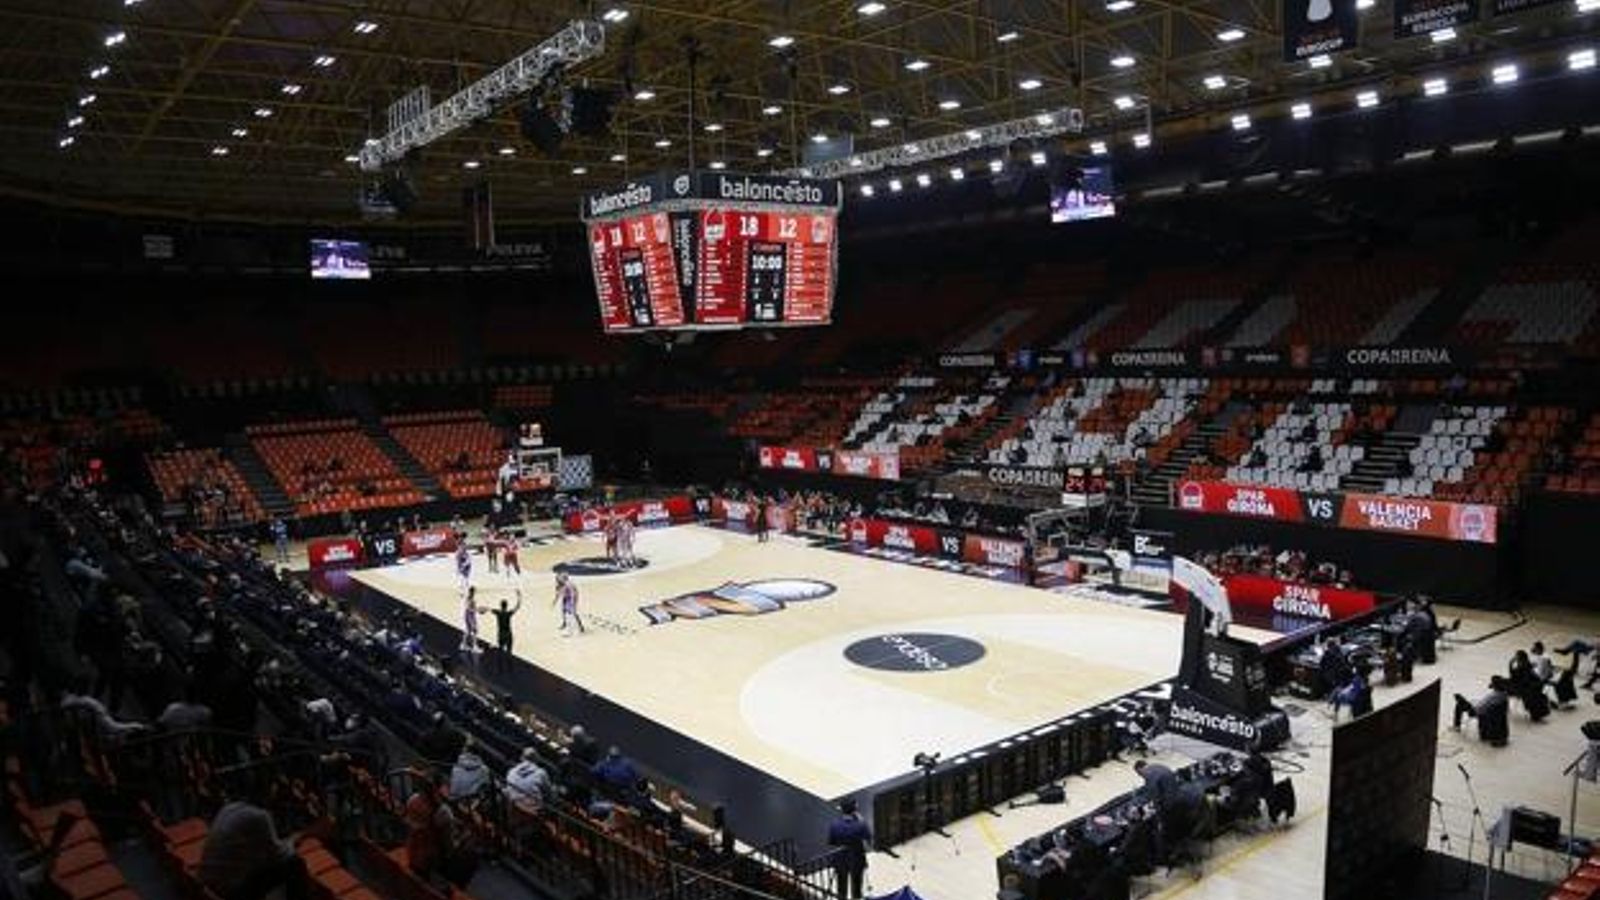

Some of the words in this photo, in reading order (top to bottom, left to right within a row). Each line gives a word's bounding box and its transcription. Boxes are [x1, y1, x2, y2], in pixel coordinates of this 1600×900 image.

[720, 175, 823, 202] baloncesto
[591, 183, 652, 215] baloncesto
[739, 215, 759, 236] 18
[778, 217, 799, 239] 12
[752, 254, 783, 270] 10:00
[1308, 498, 1334, 519] VS
[1357, 500, 1432, 520] VALENCIA
[1369, 514, 1421, 530] BASKET
[375, 539, 396, 555] VS
[942, 536, 959, 553] VS
[1285, 585, 1321, 602] SPAR
[1272, 594, 1332, 620] GIRONA
[1169, 702, 1254, 738] baloncesto
